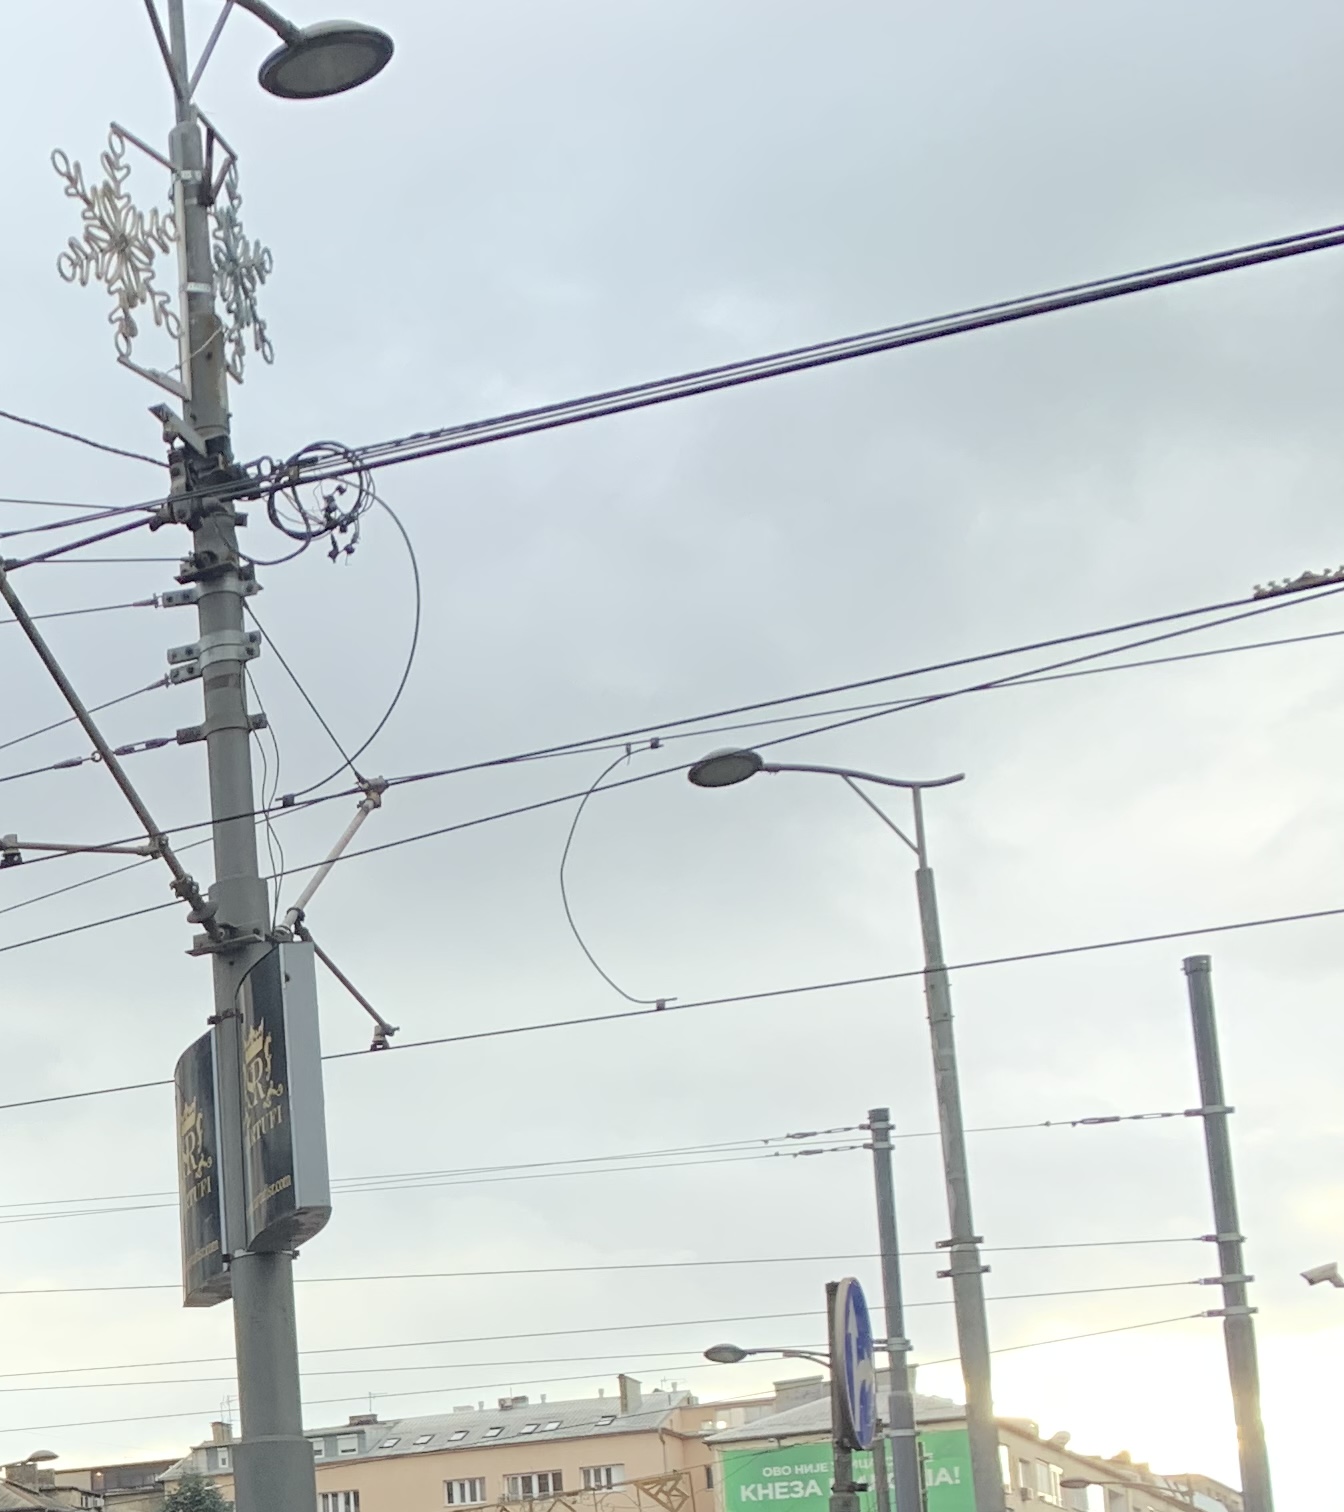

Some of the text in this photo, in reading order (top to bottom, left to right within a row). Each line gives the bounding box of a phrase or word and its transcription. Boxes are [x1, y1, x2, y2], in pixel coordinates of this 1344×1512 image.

[762, 1465, 792, 1478] ОВО
[794, 1461, 829, 1475] НИЈЕ
[740, 1478, 823, 1502] КНЕЗА
